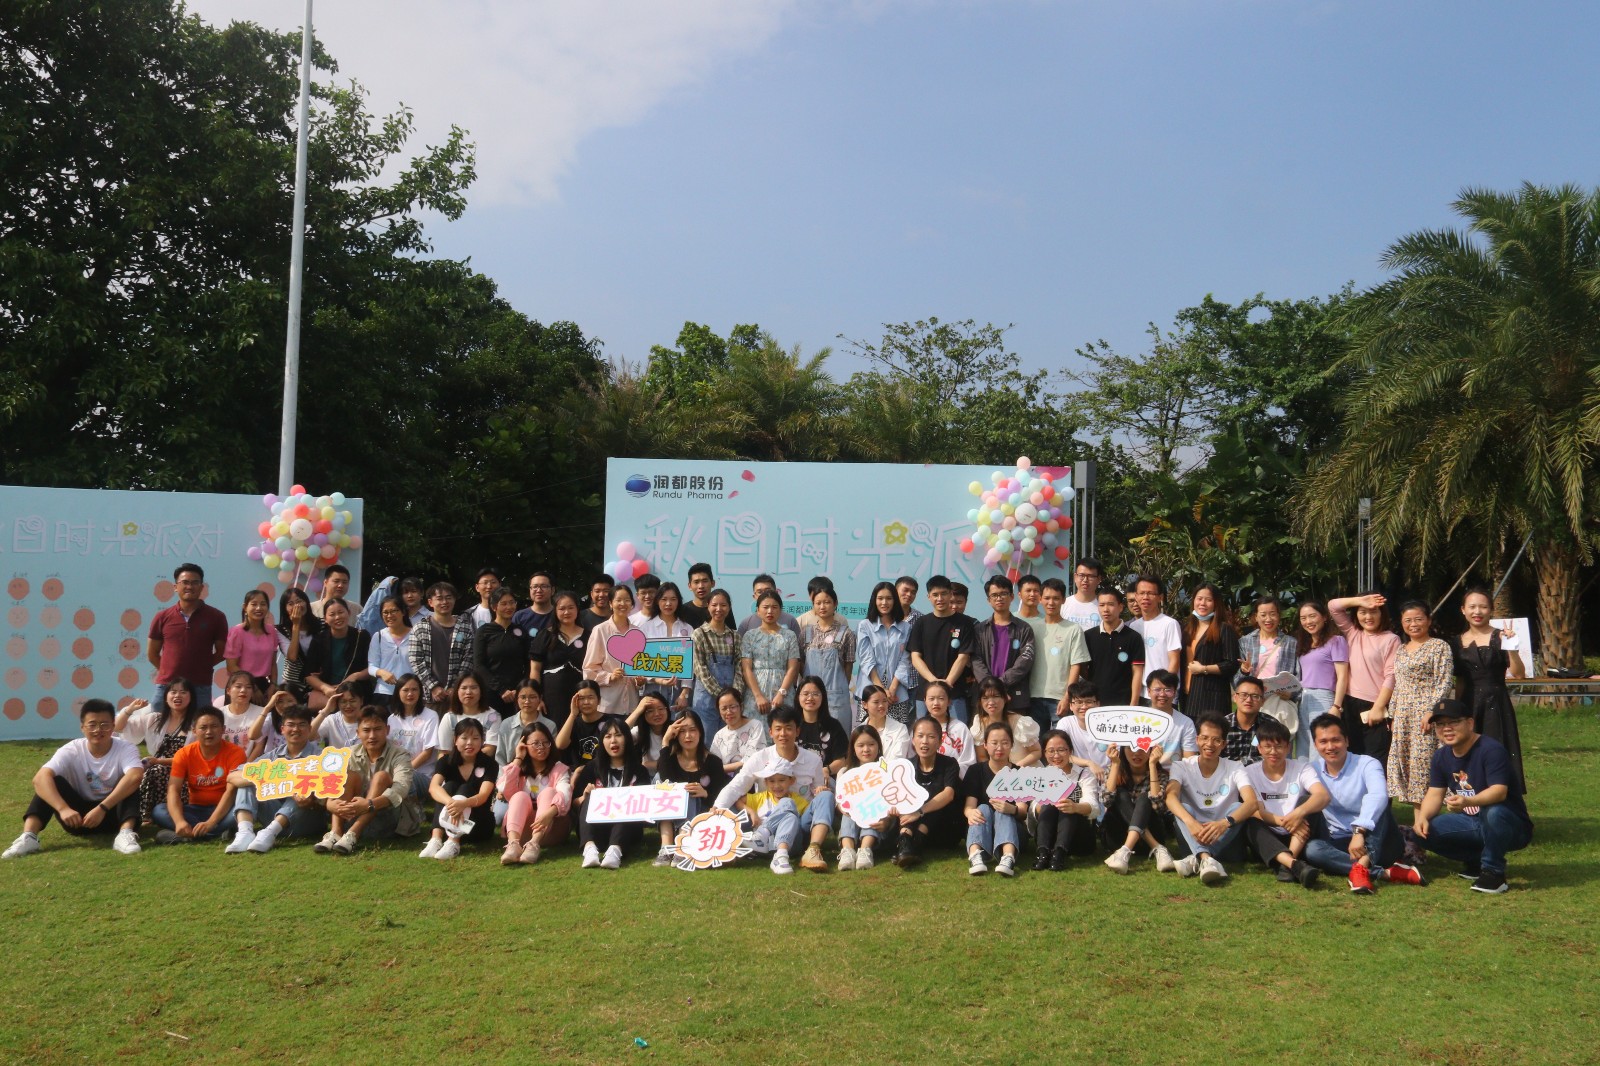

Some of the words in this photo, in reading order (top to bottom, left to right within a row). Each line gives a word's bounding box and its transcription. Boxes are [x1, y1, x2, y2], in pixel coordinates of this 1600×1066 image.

[653, 475, 723, 490] 润都股份
[652, 490, 682, 499] Rundu
[687, 491, 723, 500] Pharma
[632, 652, 684, 673] 伐木累
[246, 760, 319, 780] 时光不老
[261, 774, 344, 797] 我们不变
[594, 792, 682, 817] 小仙女
[698, 826, 726, 851] 劲
